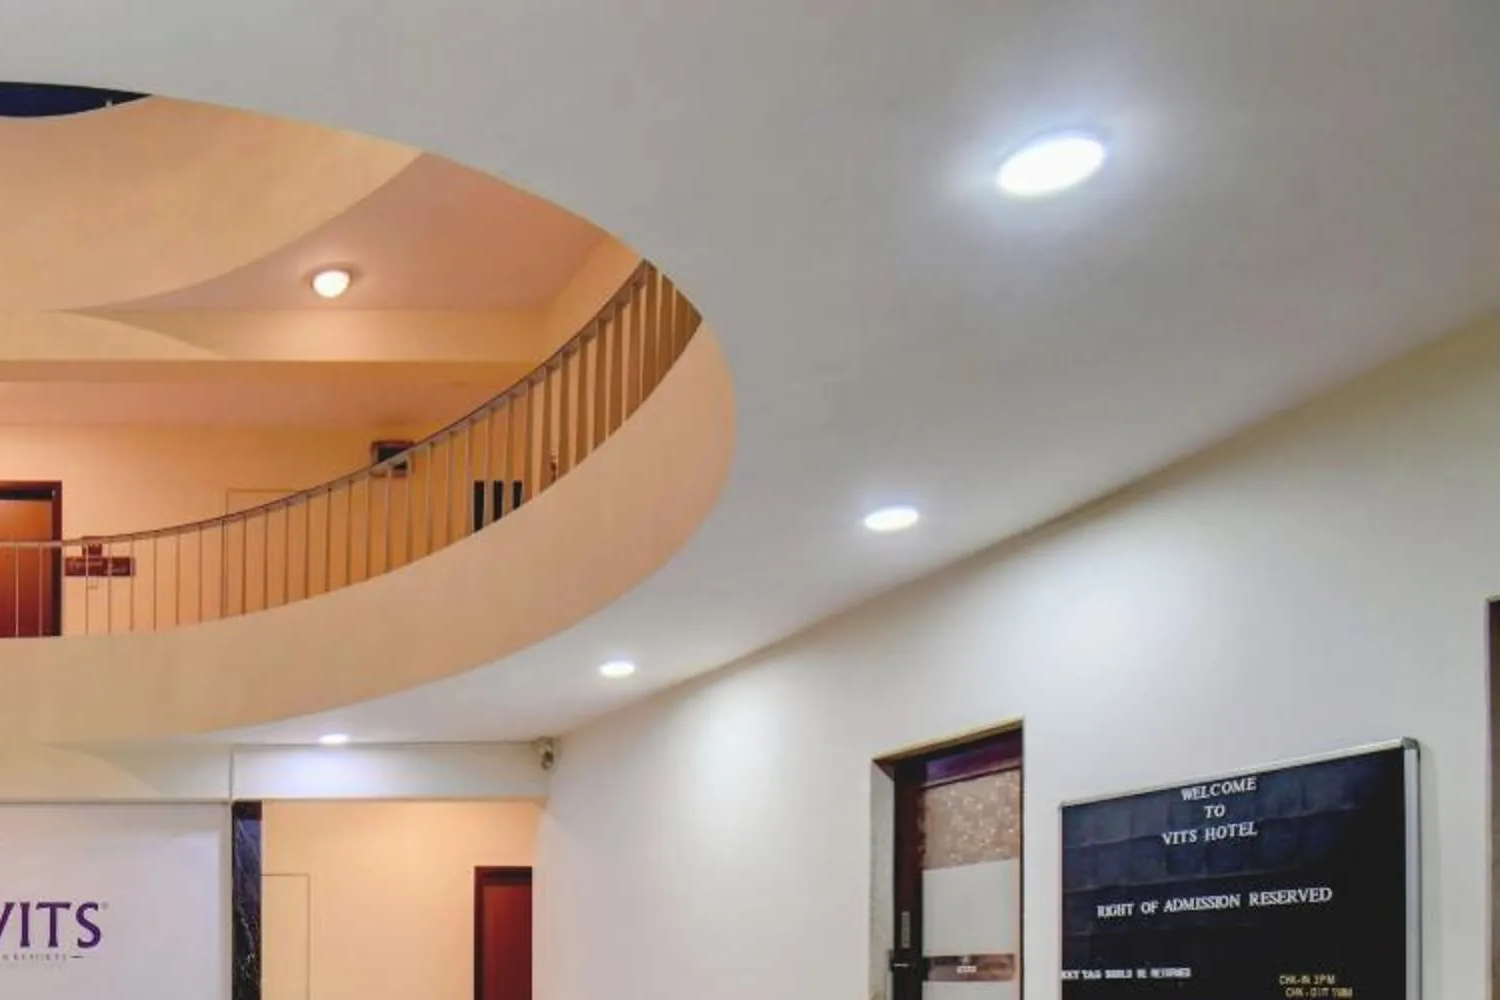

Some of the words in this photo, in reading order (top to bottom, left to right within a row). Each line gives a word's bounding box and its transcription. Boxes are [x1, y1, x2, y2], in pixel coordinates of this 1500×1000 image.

[1181, 776, 1257, 801] WELCOME
[1203, 803, 1226, 819] TO
[1161, 828, 1198, 846] VITS
[1203, 820, 1258, 842] HOTEL
[1096, 903, 1134, 918] RIGHT
[1140, 900, 1159, 915] OF
[1163, 893, 1242, 913] ADMISSION
[1248, 886, 1334, 907] RESERVED
[1104, 968, 1133, 979] SLD
